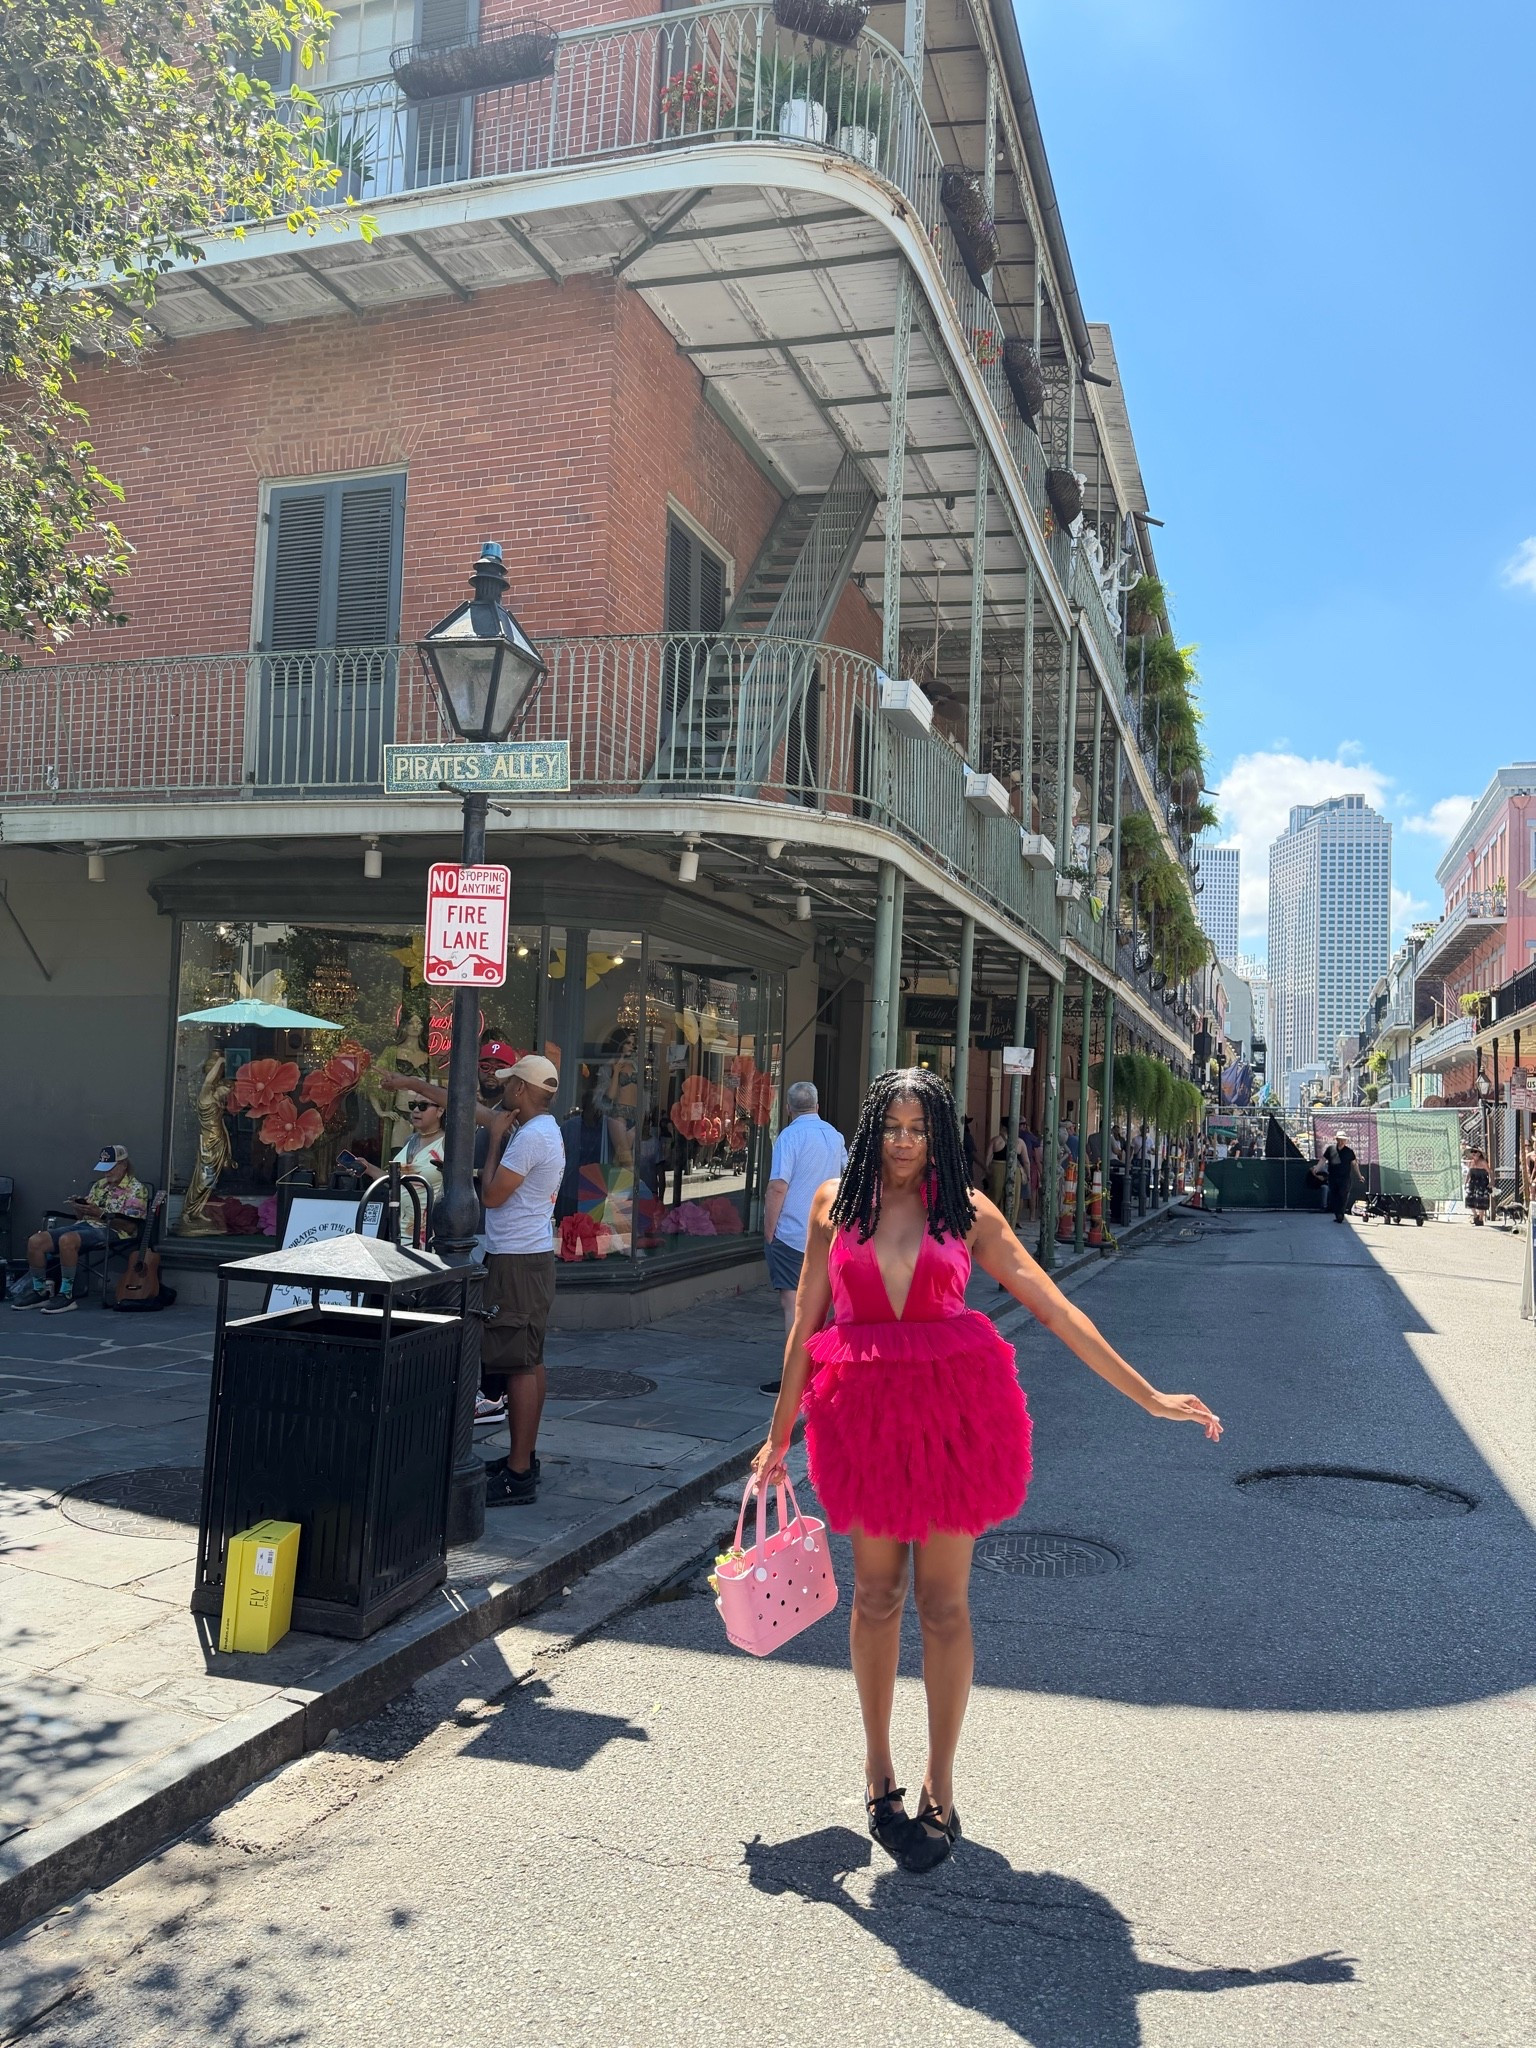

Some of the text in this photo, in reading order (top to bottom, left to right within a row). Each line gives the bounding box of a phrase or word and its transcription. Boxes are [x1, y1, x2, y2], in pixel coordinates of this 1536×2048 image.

[396, 754, 558, 780] PIRATES ALLEY
[432, 870, 505, 893] NO STOPPING
[461, 883, 501, 894] ANYTIME
[447, 905, 487, 924] FIRE
[443, 931, 489, 950] LANE
[491, 1044, 501, 1054] P
[318, 1223, 329, 1231] OF
[330, 1222, 346, 1232] THE
[986, 1549, 1089, 1565] SEWER
[250, 1588, 265, 1608] FLY
